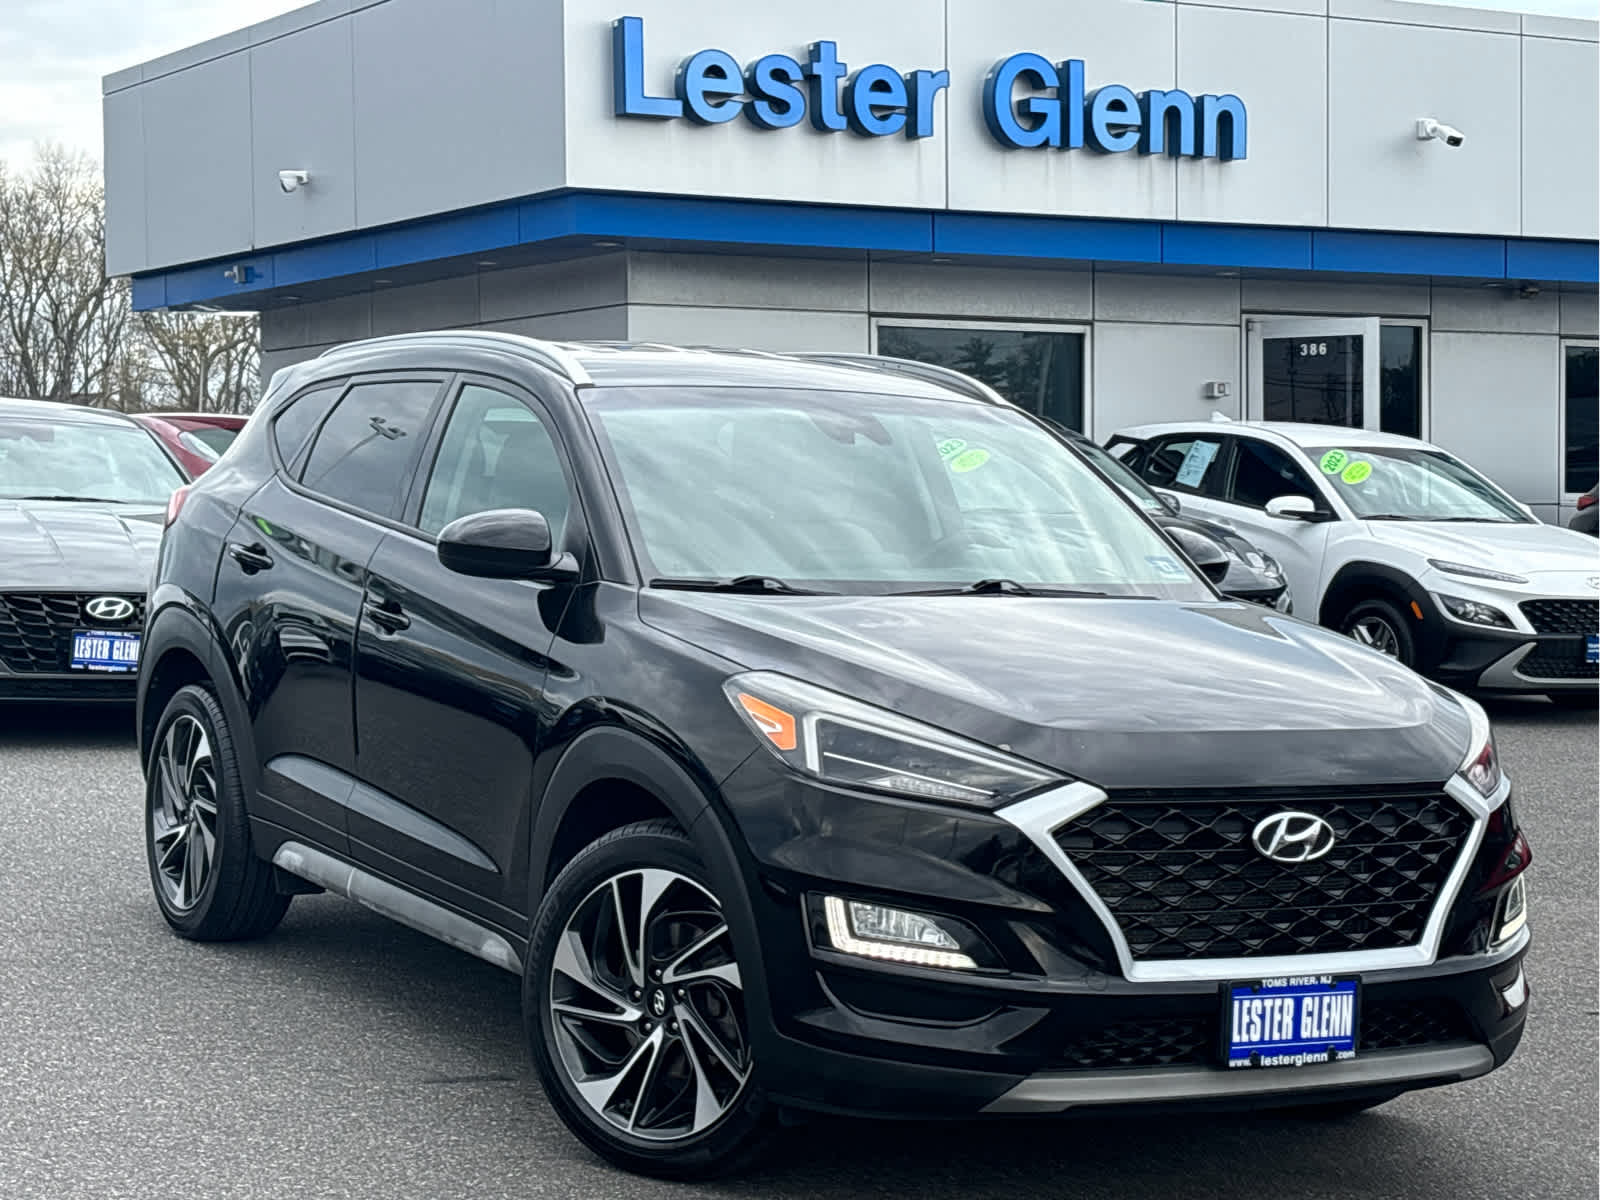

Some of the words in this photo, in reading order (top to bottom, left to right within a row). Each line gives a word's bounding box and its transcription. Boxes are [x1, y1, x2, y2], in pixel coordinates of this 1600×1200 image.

[612, 16, 949, 139] Lester
[983, 52, 1247, 161] Glenn
[1300, 343, 1327, 356] 386
[74, 639, 110, 659] LESTER
[1262, 978, 1287, 988] TOMS
[1320, 976, 1332, 984] NJ
[1232, 997, 1294, 1043] LESTER
[1301, 995, 1353, 1039] GLENN
[1261, 1051, 1328, 1067] lesterglenn
